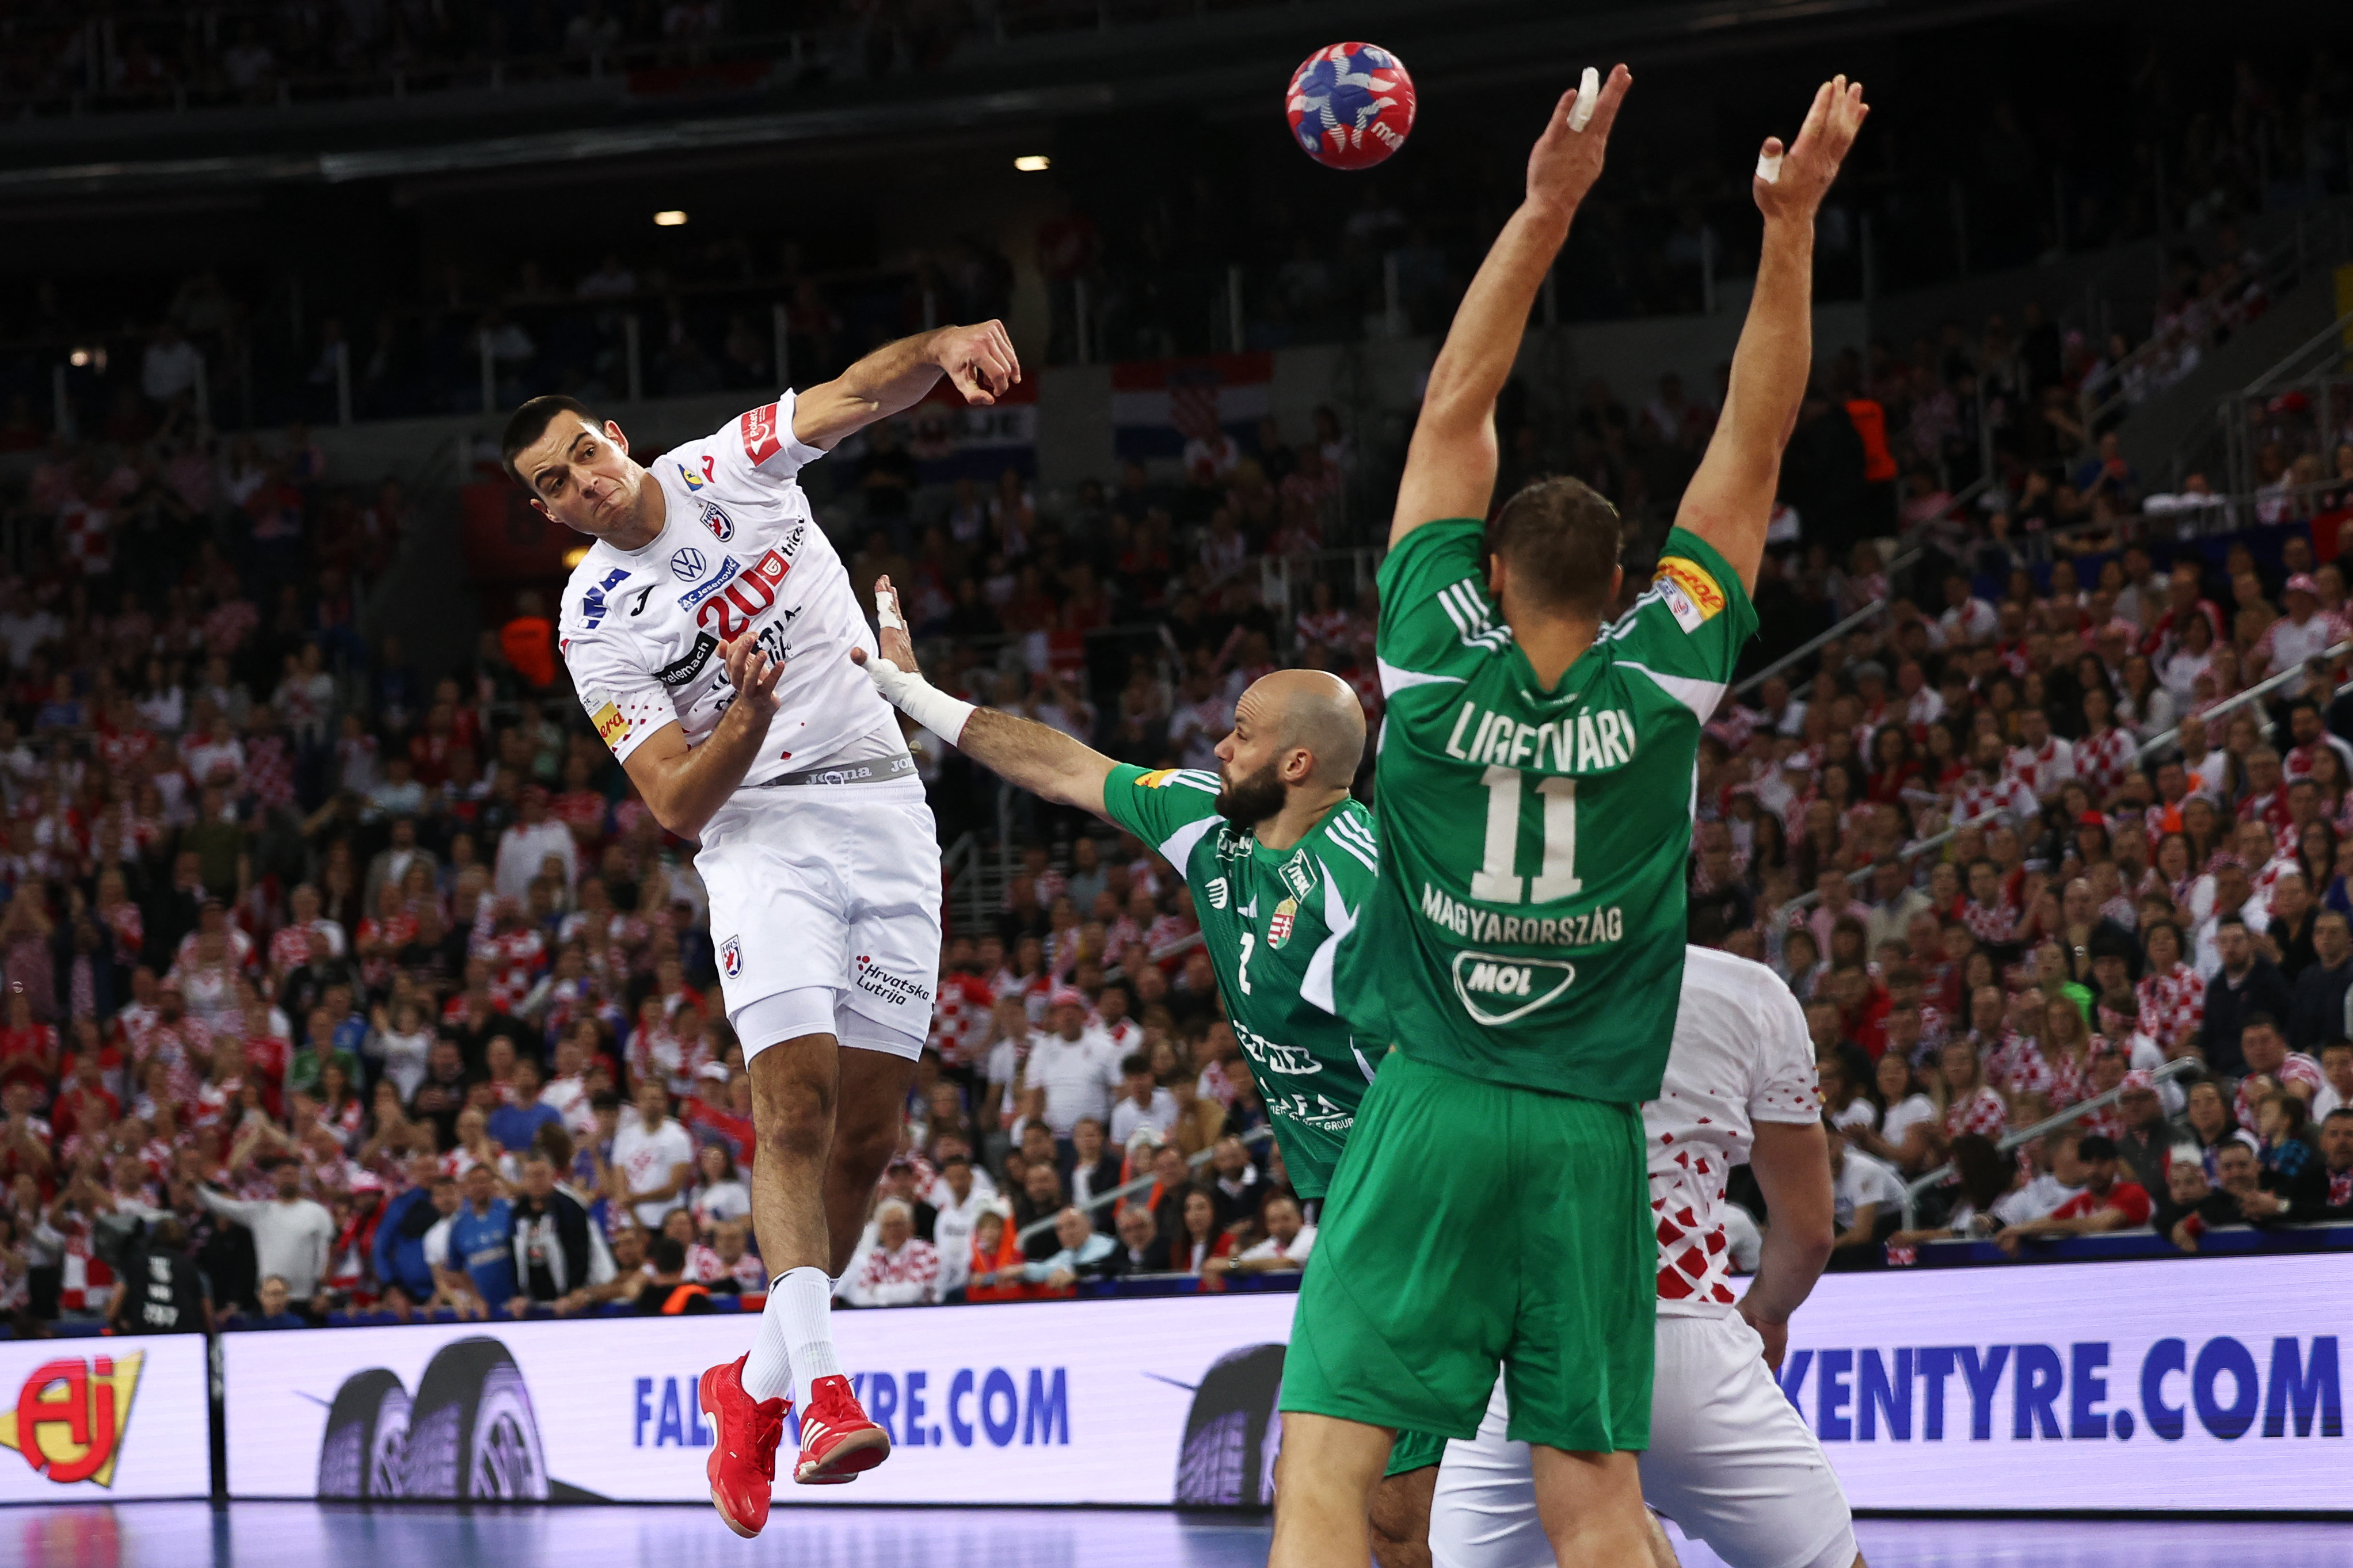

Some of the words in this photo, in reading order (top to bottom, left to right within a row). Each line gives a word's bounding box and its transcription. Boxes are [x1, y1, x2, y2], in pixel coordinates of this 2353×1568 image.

[703, 505, 717, 525] HRS
[683, 593, 697, 608] AC
[698, 557, 736, 597] Jesenović
[696, 569, 775, 643] 20
[660, 641, 709, 683] telemach
[1470, 764, 1583, 905] 11
[1287, 864, 1311, 896] JYSK
[1421, 882, 1623, 946] MAGYARORSZÁG
[722, 938, 737, 953] HRS
[856, 975, 907, 1006] Lutrija
[864, 964, 930, 1001] Hrvatska
[1467, 962, 1532, 996] MOL
[1324, 1117, 1354, 1131] GROUP
[636, 1366, 1069, 1448] FALRE.COM
